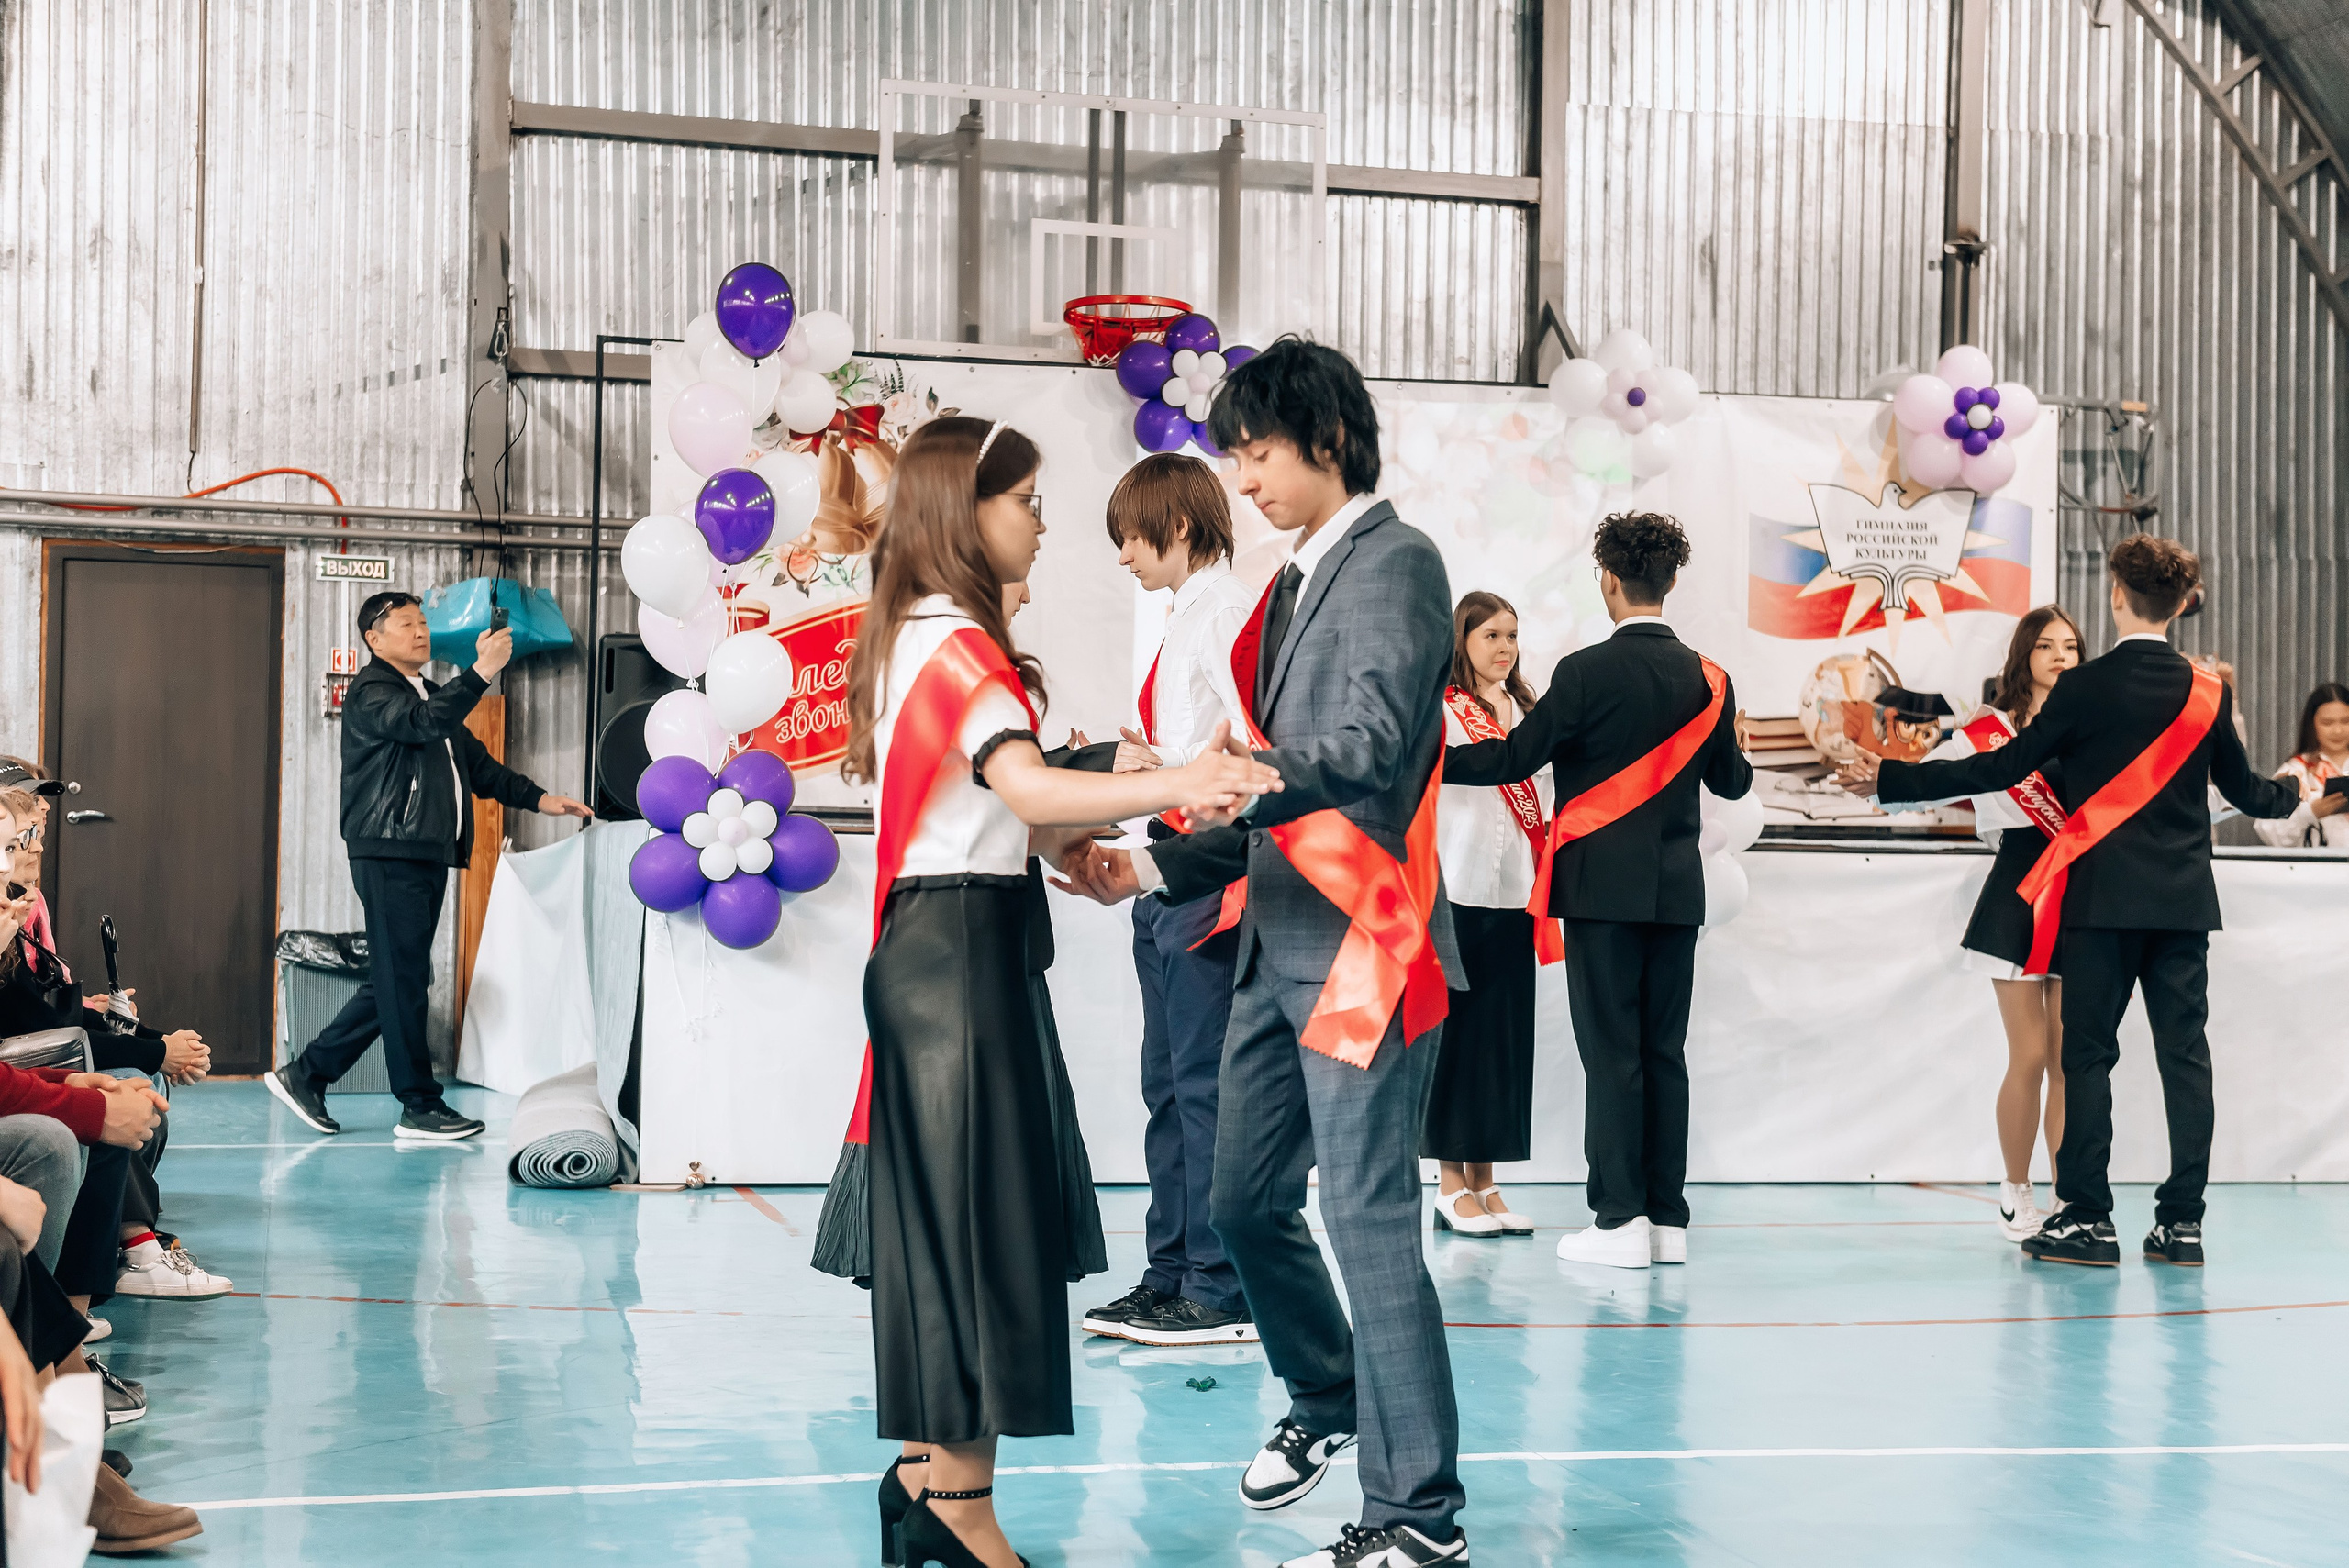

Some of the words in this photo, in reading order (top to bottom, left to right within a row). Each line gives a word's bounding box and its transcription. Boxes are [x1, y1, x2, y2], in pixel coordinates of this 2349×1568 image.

[1856, 519, 1928, 531] ГИМНАЗИЯ
[1845, 532, 1938, 546] РОССИЙСКОЙ
[1855, 549, 1927, 560] КУЛЬТУРЫ
[327, 560, 385, 579] ВЫХОД
[774, 699, 852, 744] звон
[1517, 798, 1540, 829] 2025
